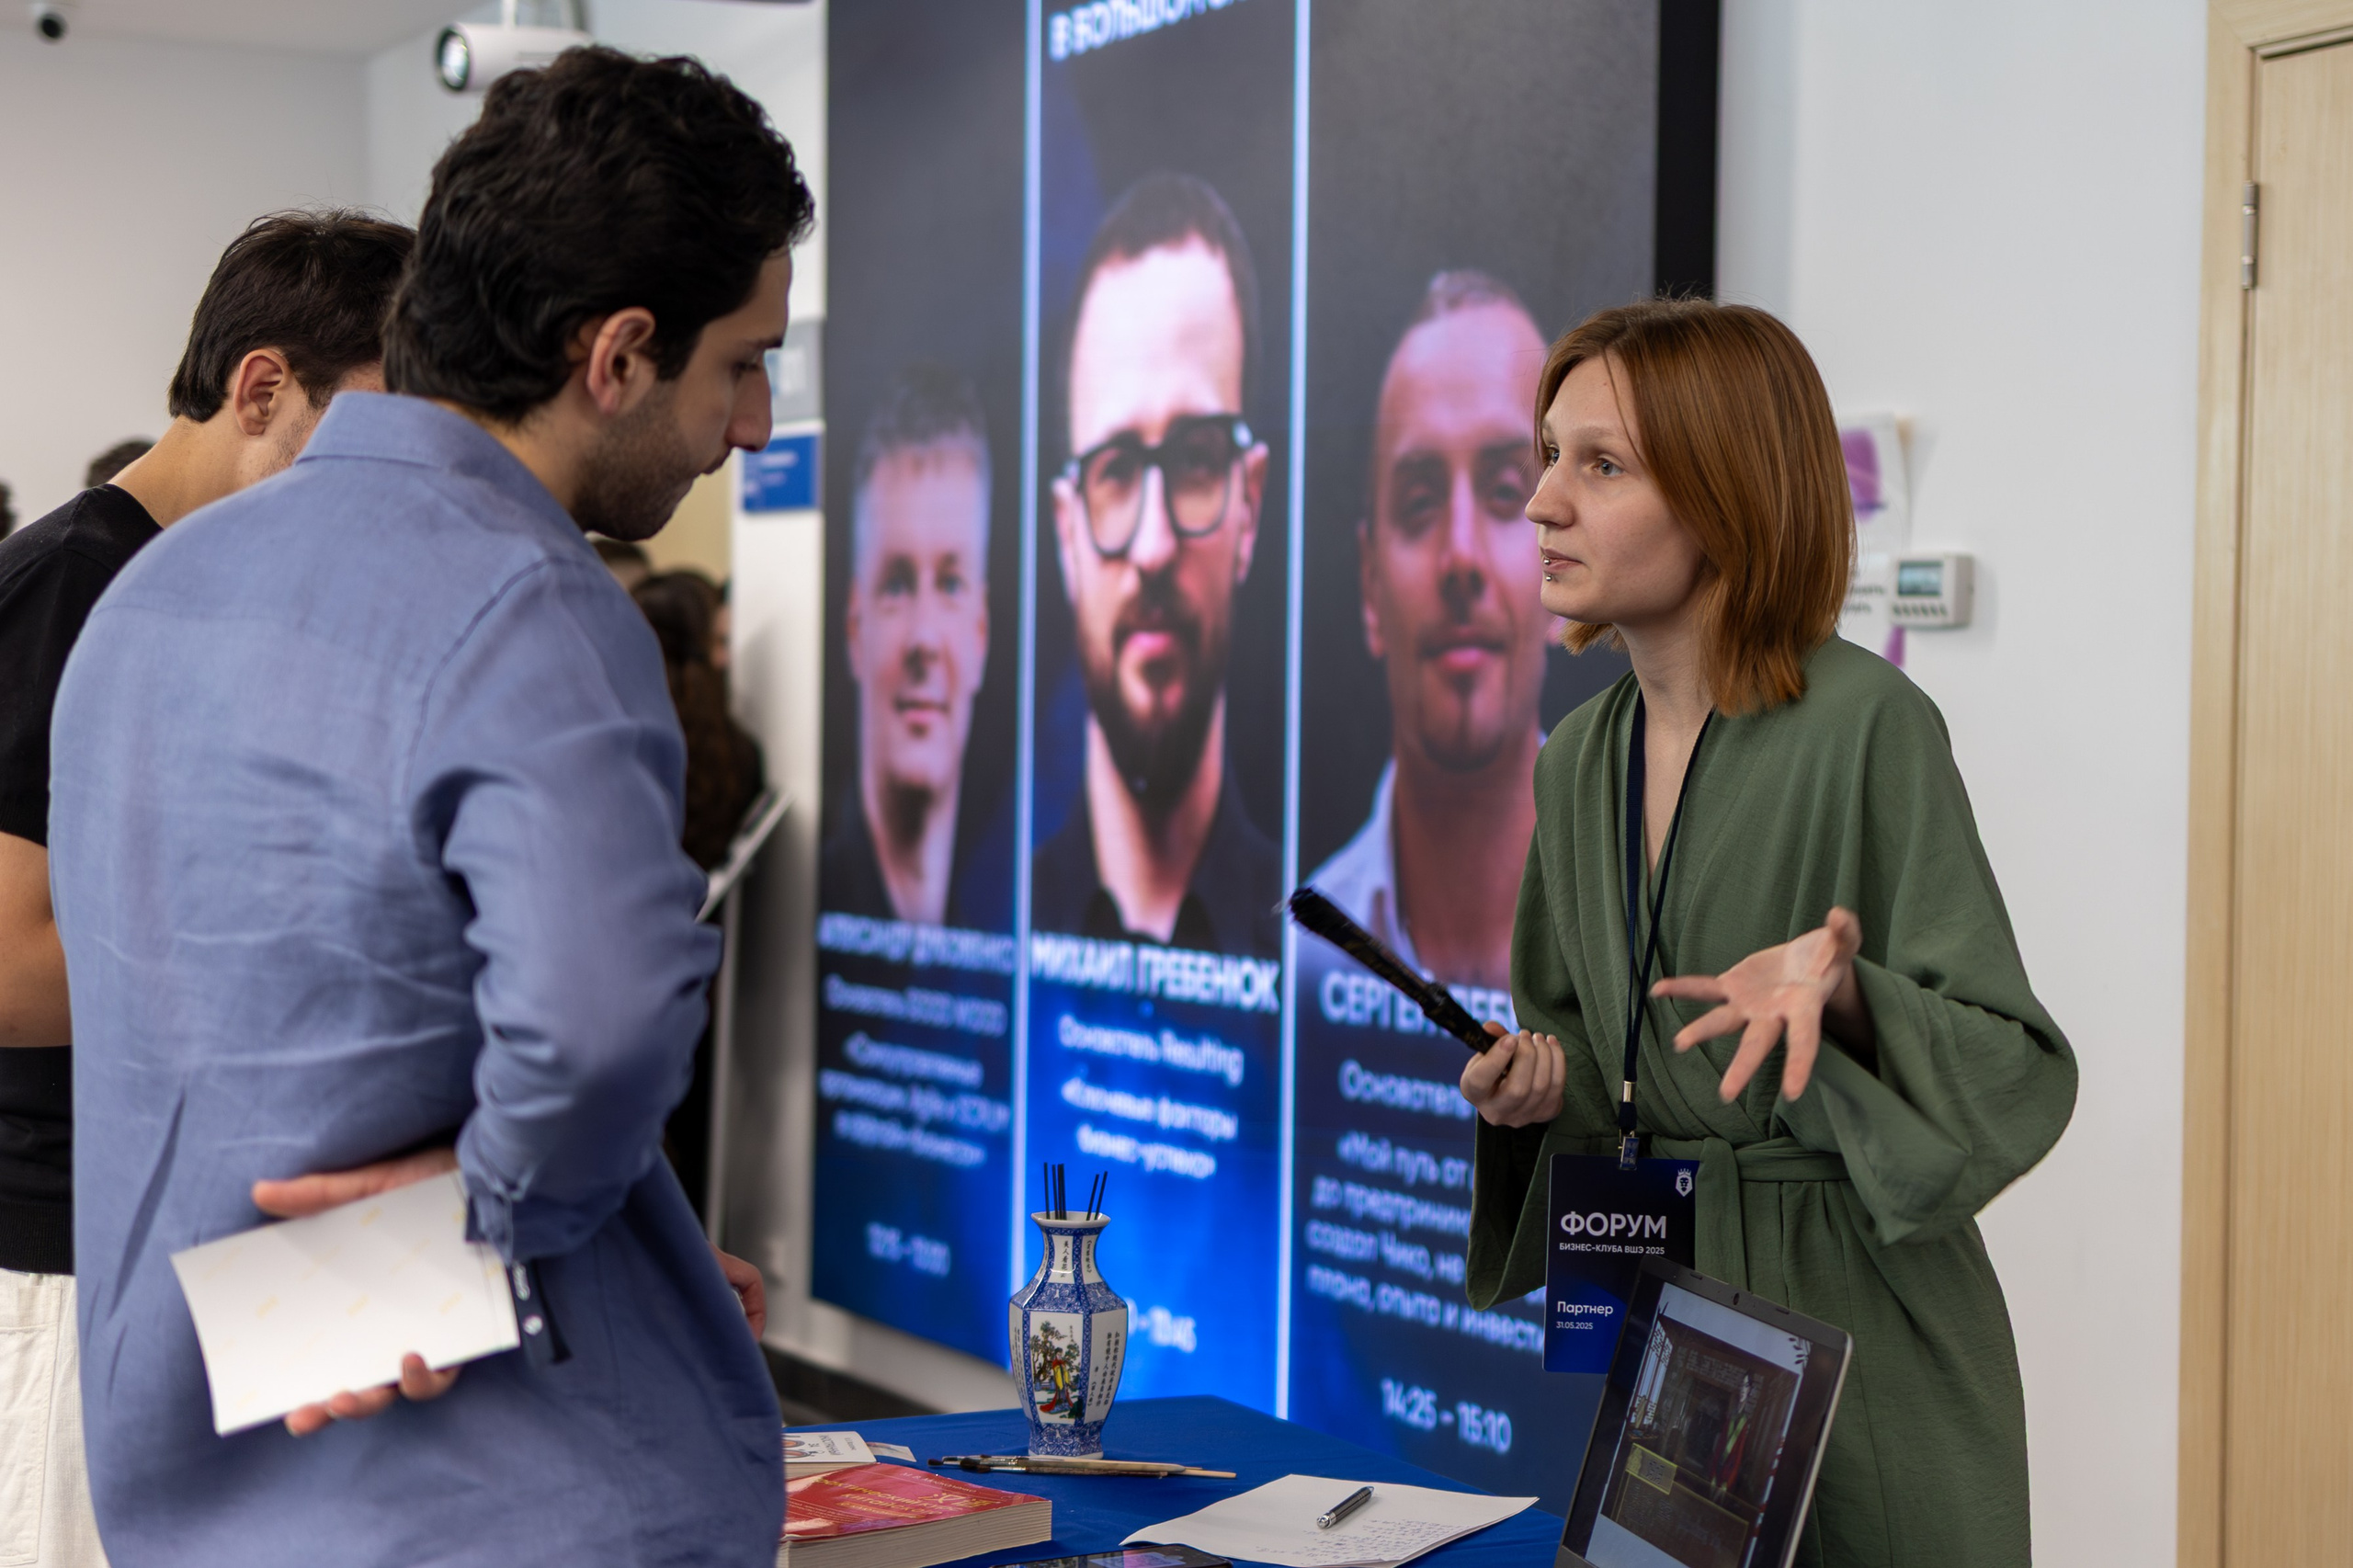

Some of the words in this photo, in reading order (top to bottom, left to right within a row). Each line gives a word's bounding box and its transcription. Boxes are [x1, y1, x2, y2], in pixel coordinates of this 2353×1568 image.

[1136, 944, 1279, 1014] ГРЕБЕНЮК
[1394, 1147, 1439, 1187] путь
[1440, 1156, 1469, 1188] от
[1312, 1175, 1342, 1209] до
[1561, 1210, 1667, 1239] ФОРУМ
[1559, 1243, 1623, 1254] БИЗНЕС-КЛУБА
[1624, 1244, 1644, 1255] ВШЭ
[1645, 1246, 1665, 1256] 2025
[1376, 1283, 1440, 1327] опыта
[1557, 1301, 1614, 1318] Партнер
[1556, 1321, 1594, 1331] 31.05.2025
[1457, 1402, 1512, 1454] 15:10
